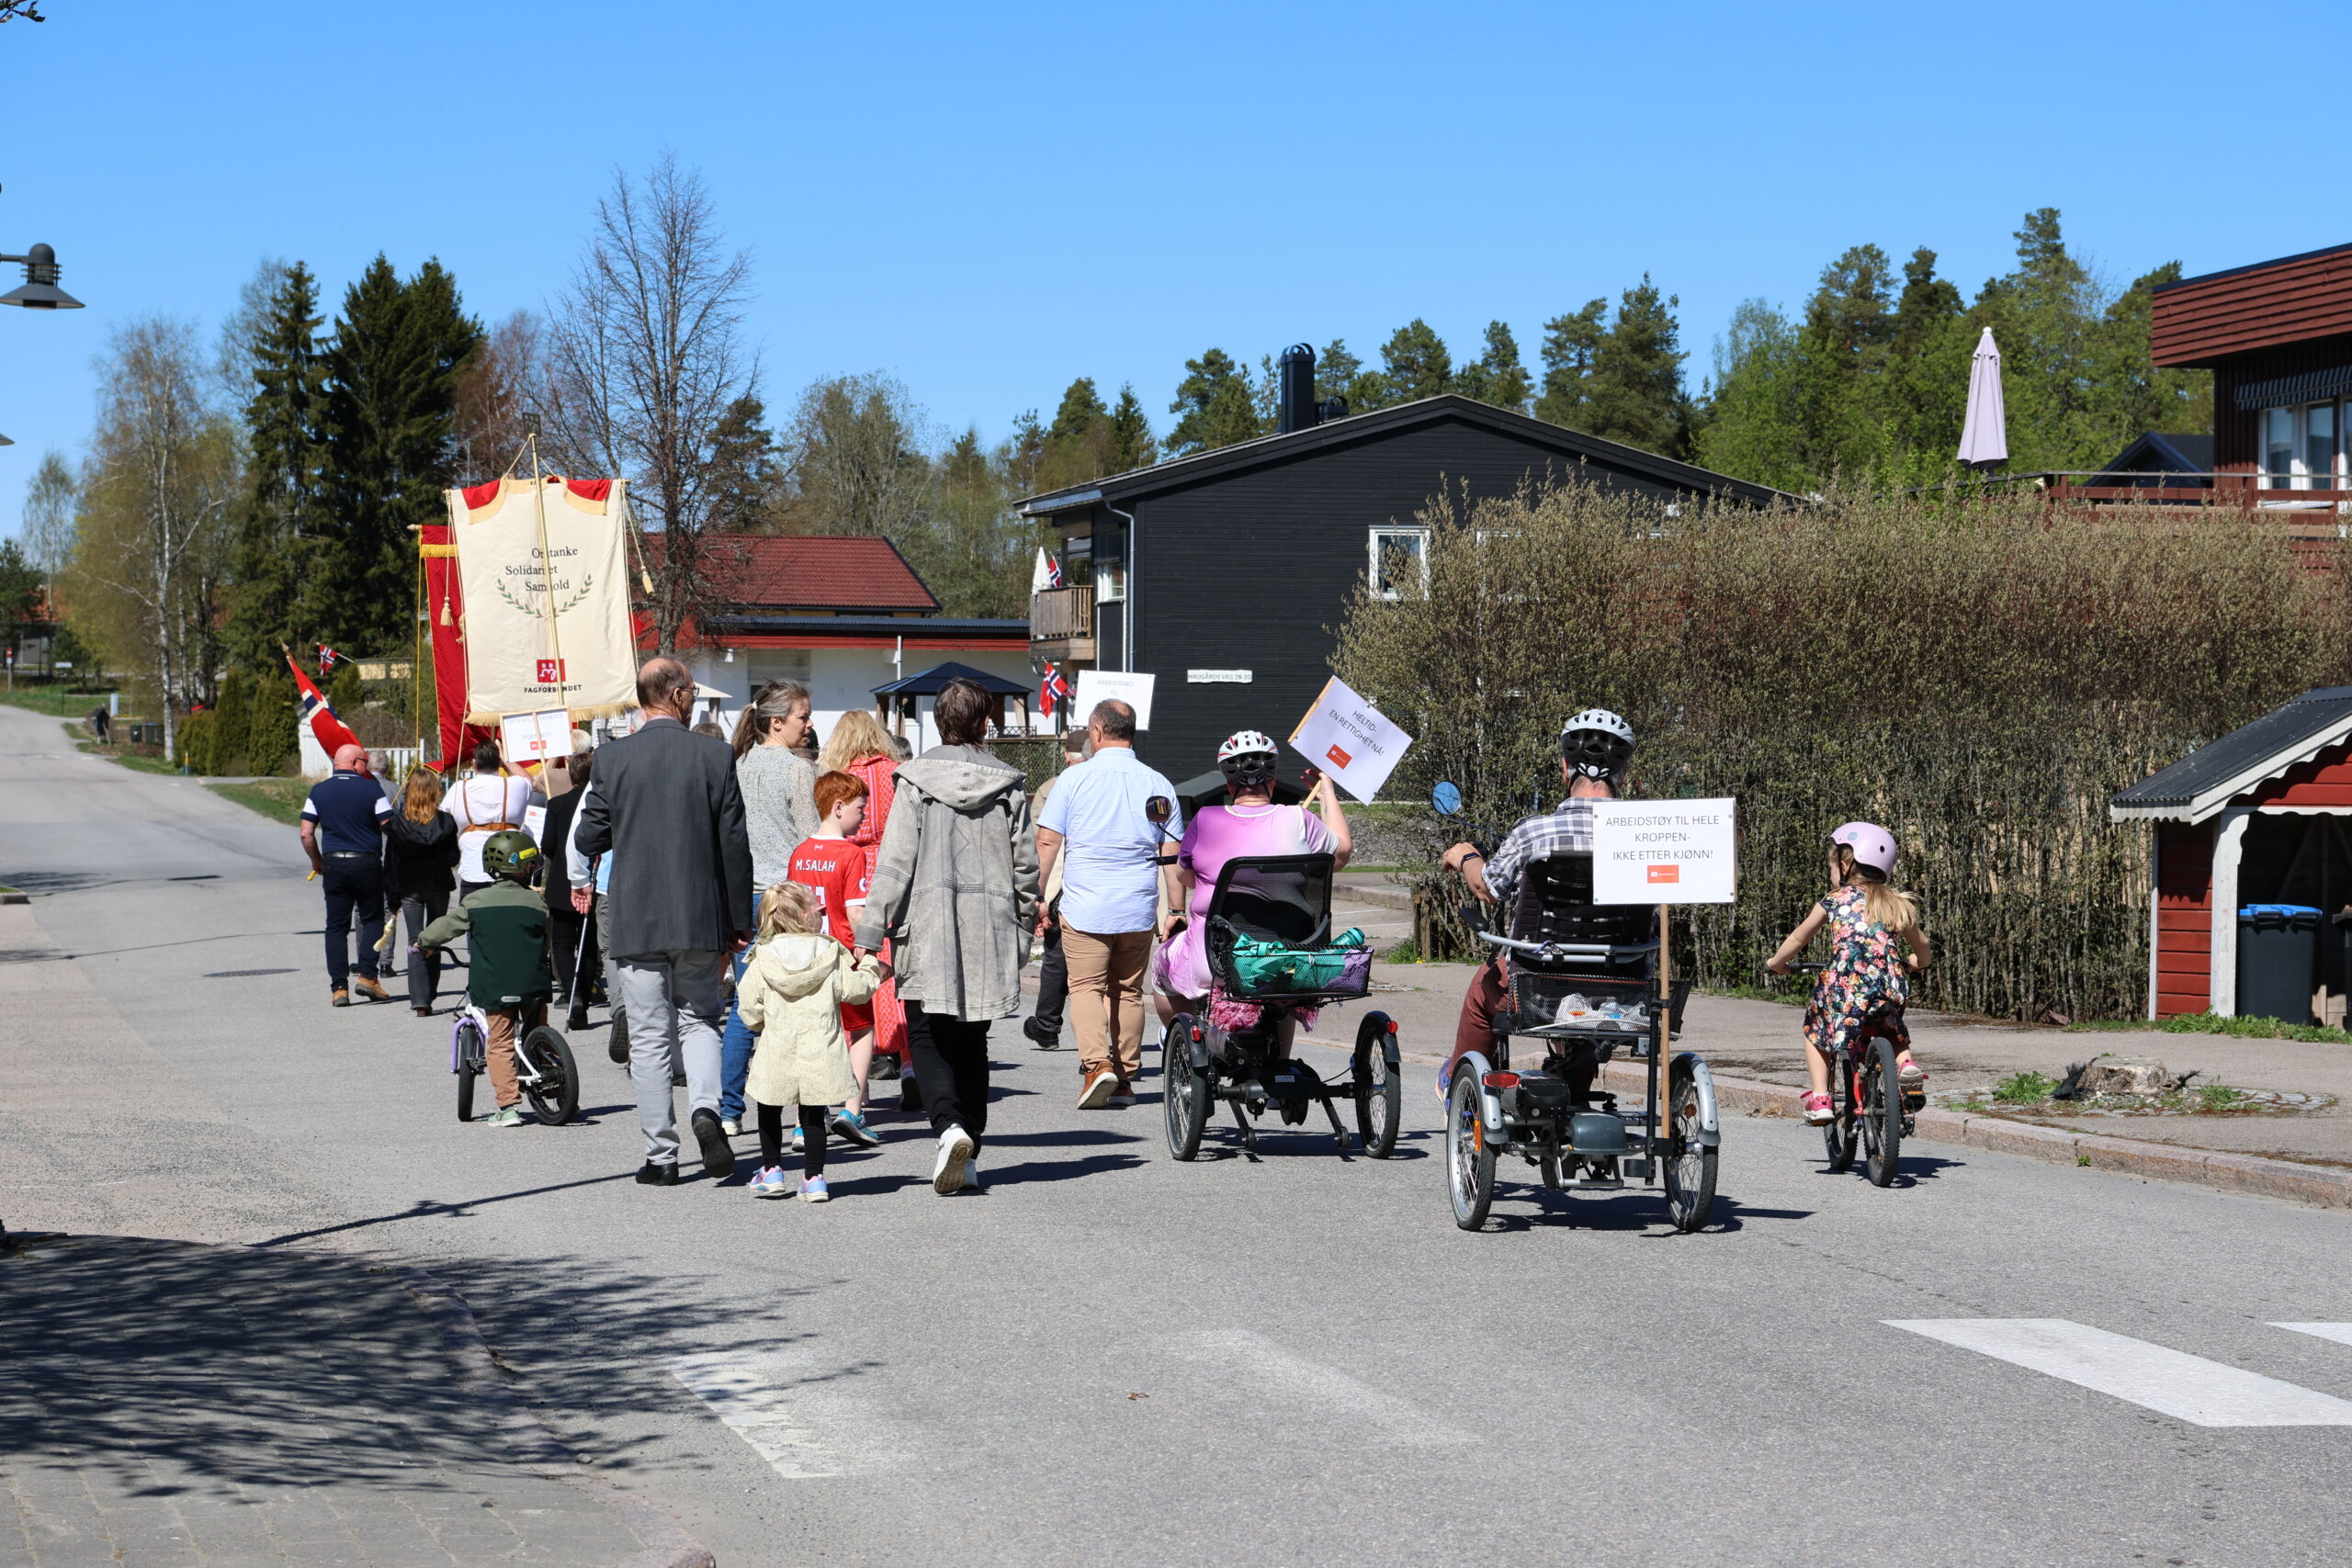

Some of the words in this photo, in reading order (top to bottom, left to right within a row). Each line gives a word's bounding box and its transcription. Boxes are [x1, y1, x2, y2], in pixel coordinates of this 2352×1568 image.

[505, 565, 558, 575] Solidariet
[525, 580, 570, 592] Samold
[1352, 710, 1376, 731] HELTID-
[1329, 709, 1339, 721] EN
[1339, 717, 1374, 748] RETTIGHET
[1372, 742, 1385, 757] NÅ!
[1606, 816, 1673, 827] ARBEIDSTØY
[1674, 816, 1690, 825] TIL
[1692, 815, 1720, 825] HELE
[1634, 832, 1690, 842] KROPPEN-
[1612, 851, 1636, 861] IKKE
[1638, 850, 1671, 861] ETTER
[1673, 850, 1713, 860] KJØNN!
[795, 859, 836, 872] M.SALAH
